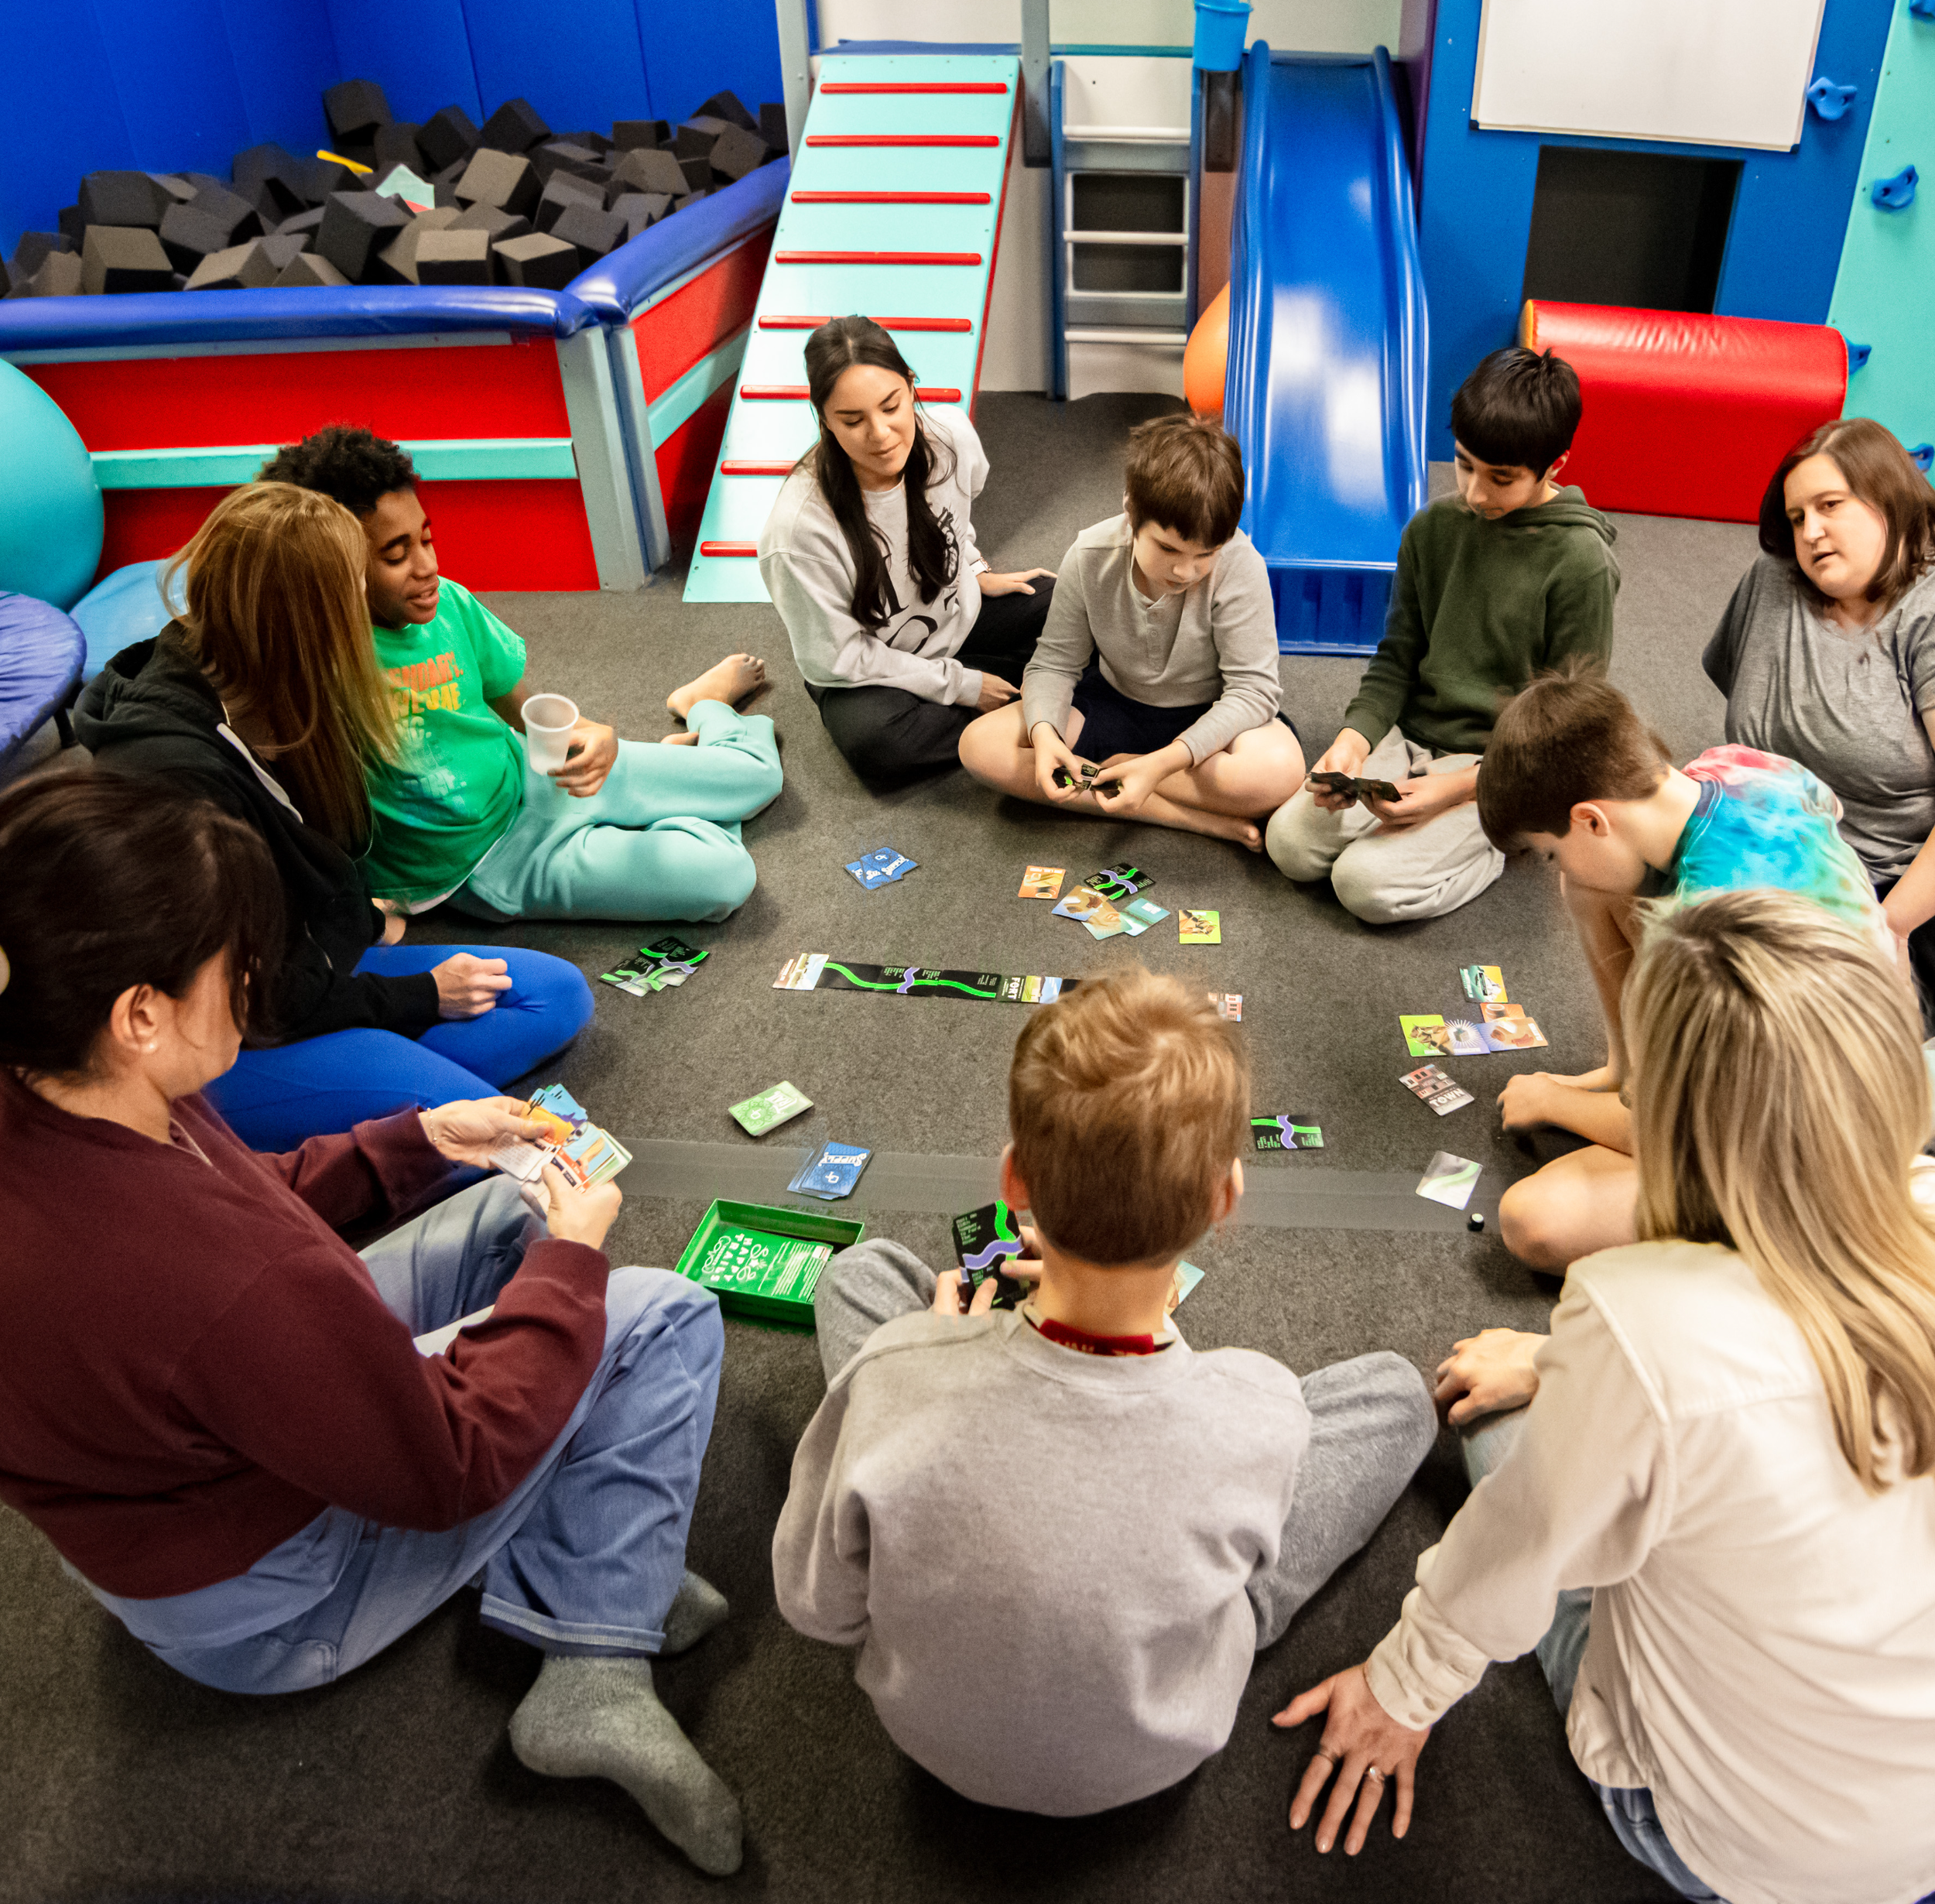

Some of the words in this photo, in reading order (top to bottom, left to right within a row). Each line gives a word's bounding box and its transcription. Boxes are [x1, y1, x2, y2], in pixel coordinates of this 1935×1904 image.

[1007, 977, 1021, 1000] FORT
[1429, 1087, 1466, 1108] TOWN
[818, 1152, 867, 1167] SUPPLY
[710, 1233, 745, 1282] TRAILS
[724, 1238, 754, 1282] HAPPY
